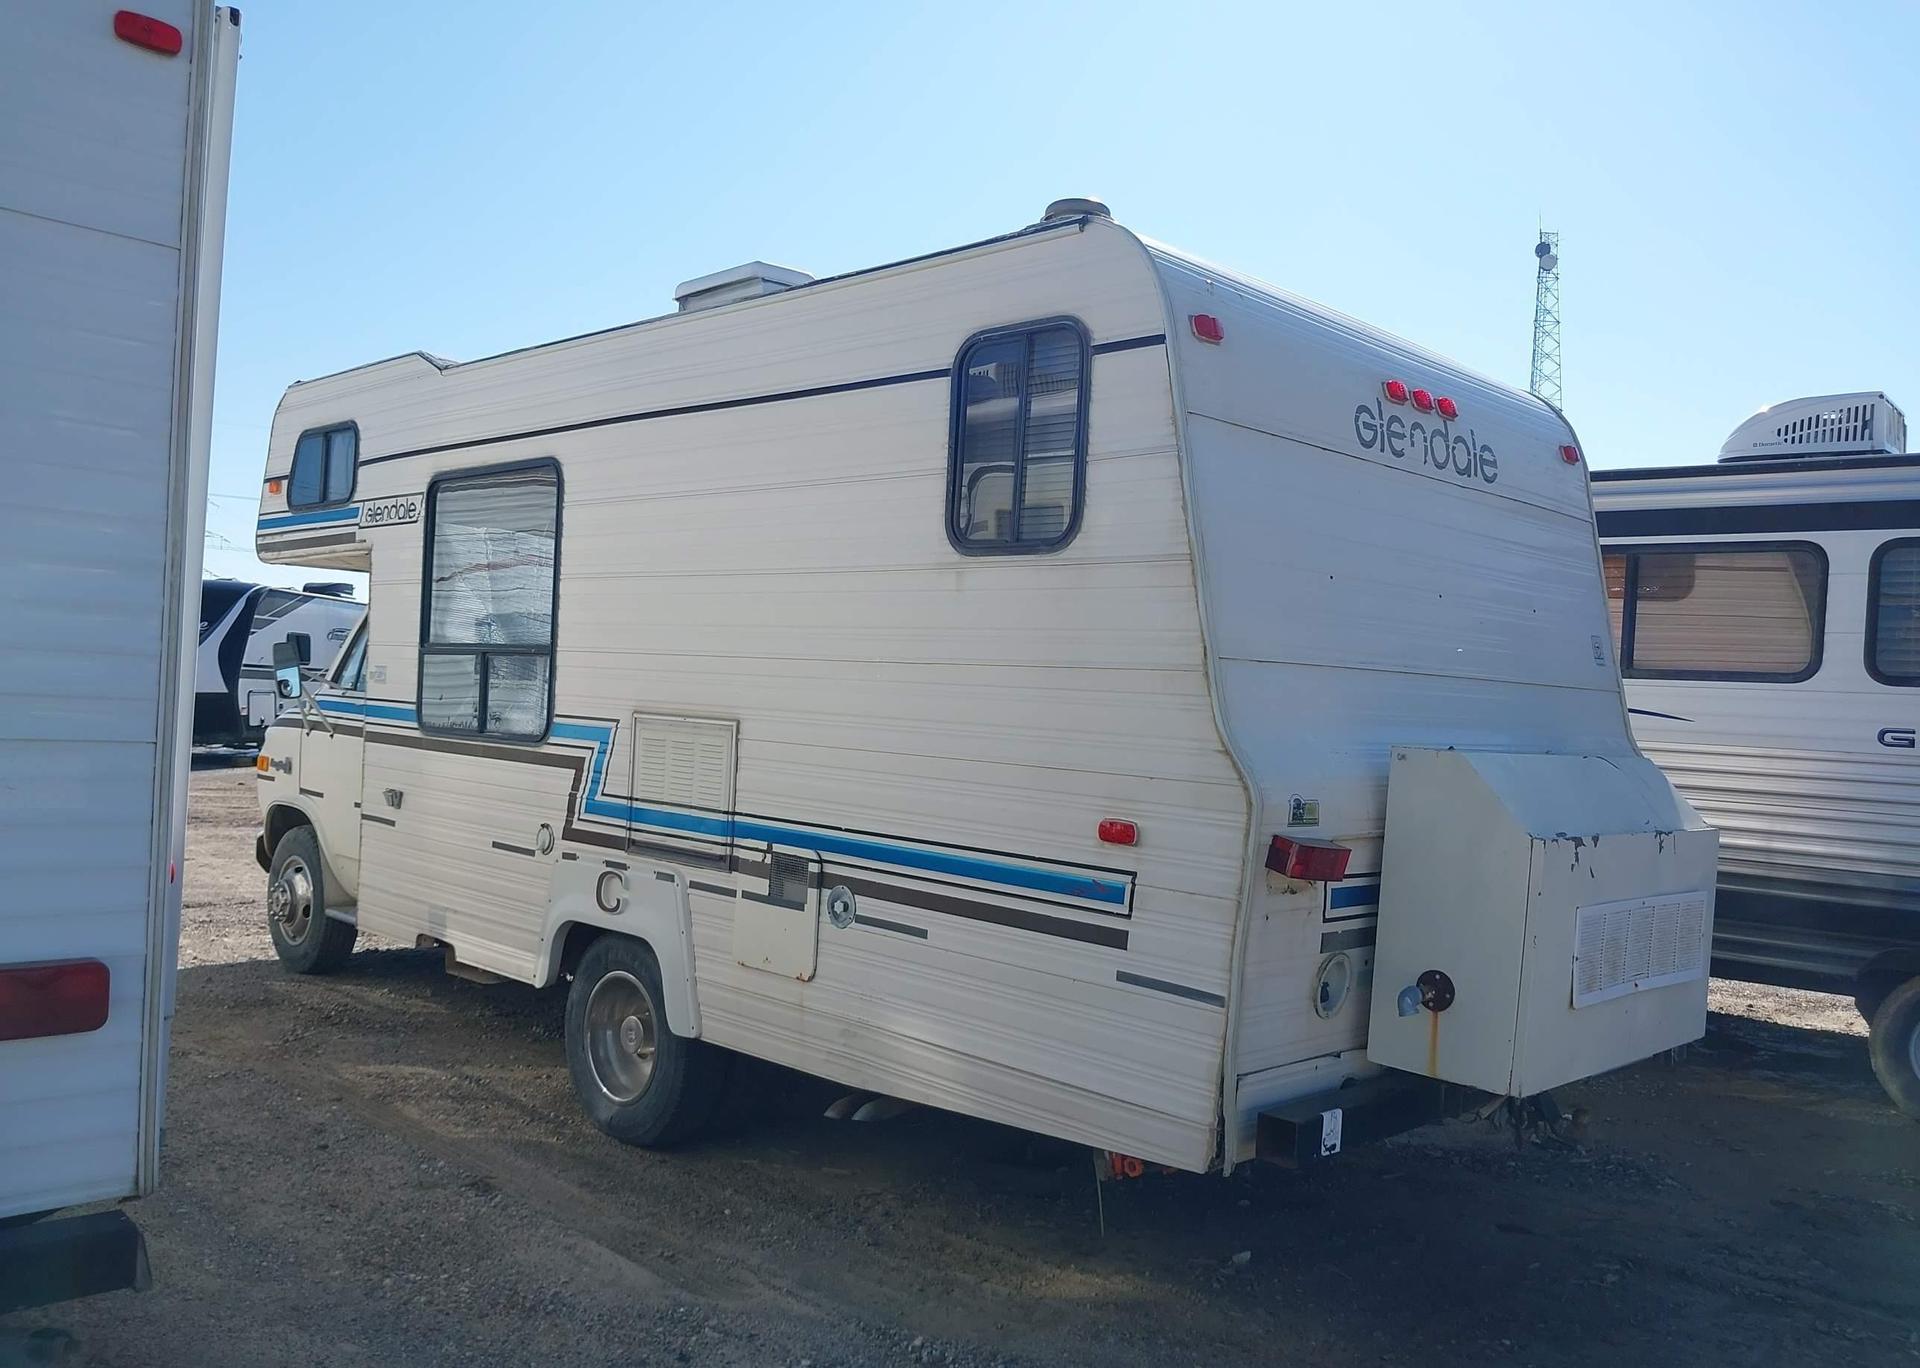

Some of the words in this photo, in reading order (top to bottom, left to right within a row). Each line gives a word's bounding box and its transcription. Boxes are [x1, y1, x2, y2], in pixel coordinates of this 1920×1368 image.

[1354, 398, 1498, 484] Glendale
[365, 498, 417, 523] Glendale
[1877, 727, 1916, 749] G
